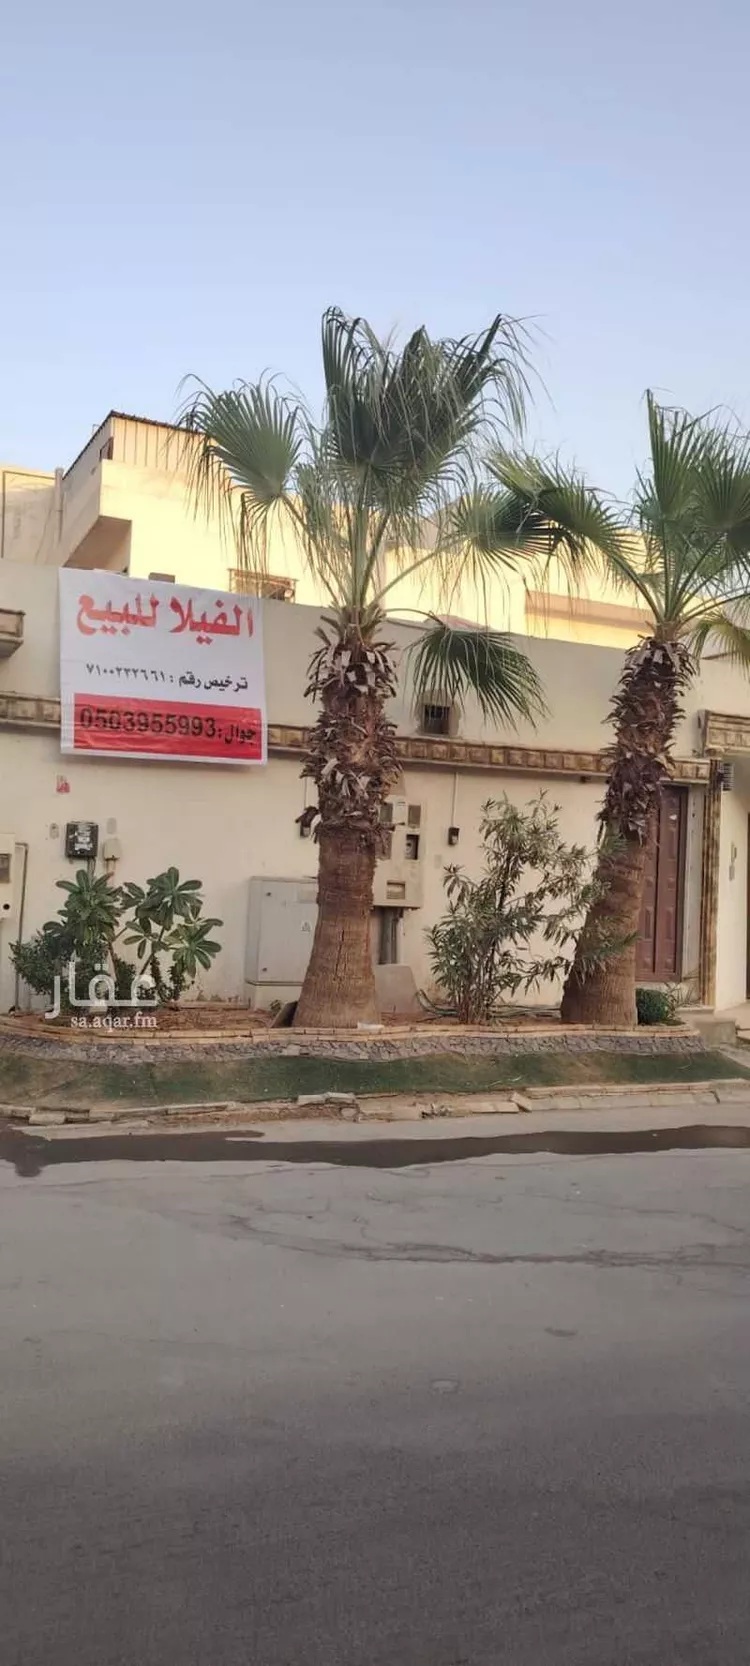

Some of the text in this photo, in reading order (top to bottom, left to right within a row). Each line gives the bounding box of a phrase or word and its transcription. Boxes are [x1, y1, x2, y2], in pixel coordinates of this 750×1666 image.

[77, 592, 255, 645] الفيلا للبيع
[178, 670, 202, 688] رقم
[203, 675, 249, 692] ترخيص
